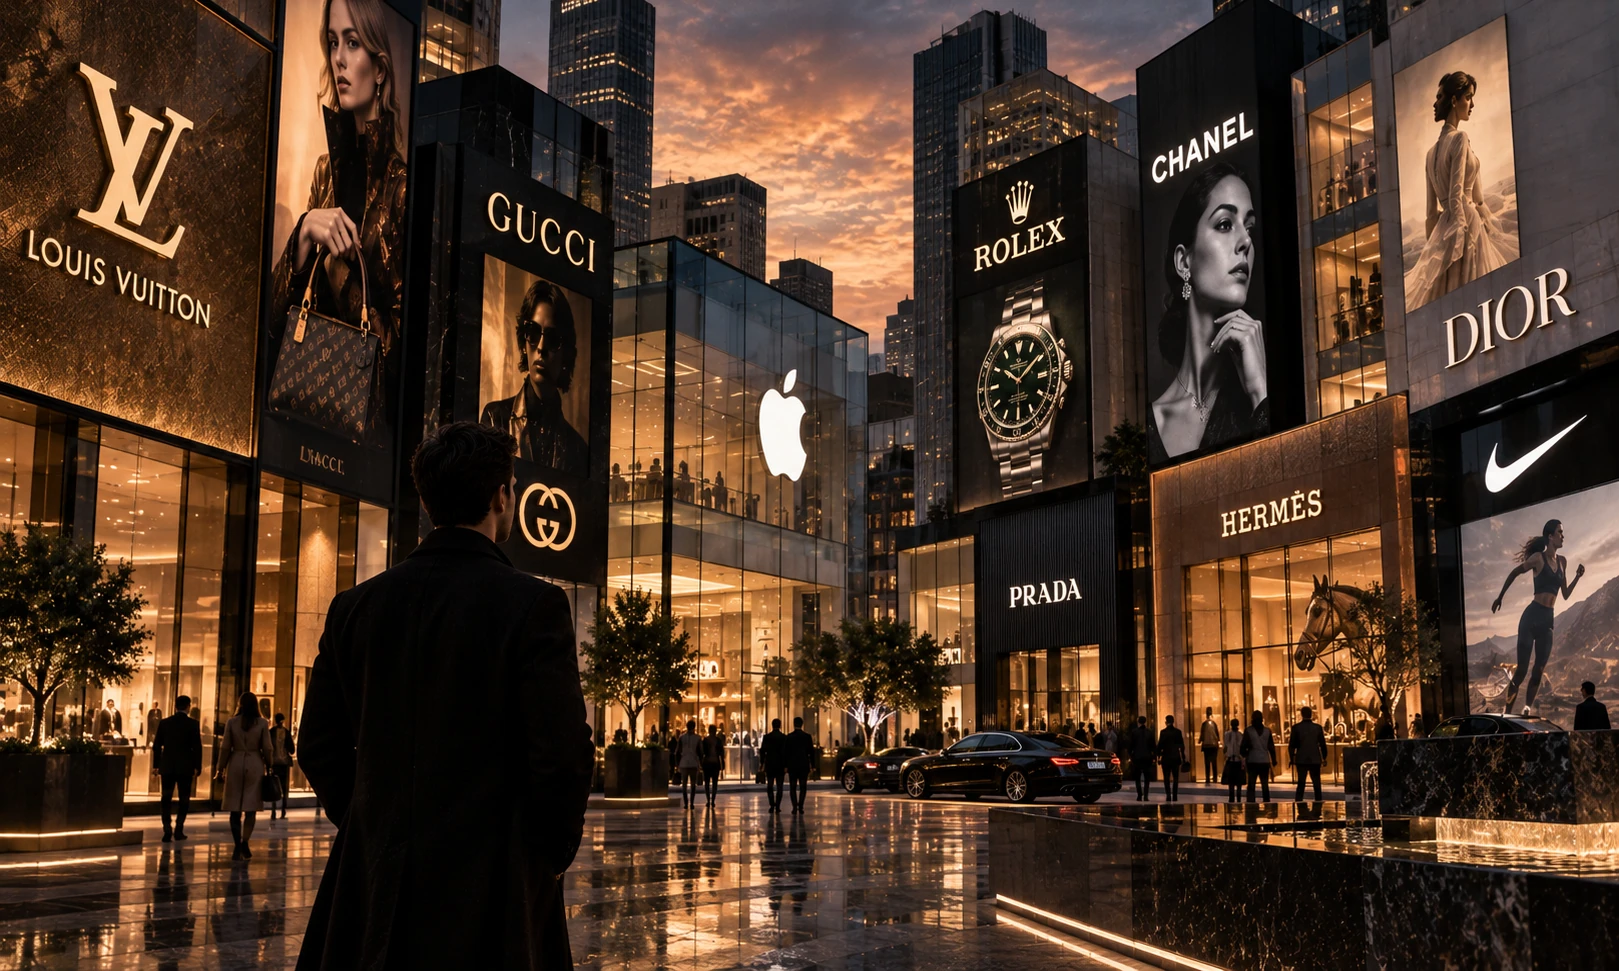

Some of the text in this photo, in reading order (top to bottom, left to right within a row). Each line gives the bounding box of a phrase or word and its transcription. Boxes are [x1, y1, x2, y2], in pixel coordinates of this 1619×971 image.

[1152, 111, 1254, 184] CHANEL
[487, 192, 596, 273] GUCCI
[973, 216, 1066, 272] ROLEX
[28, 230, 211, 329] LOUIS VUITTON
[1443, 267, 1577, 369] DIOR
[1009, 577, 1083, 608] PRADA
